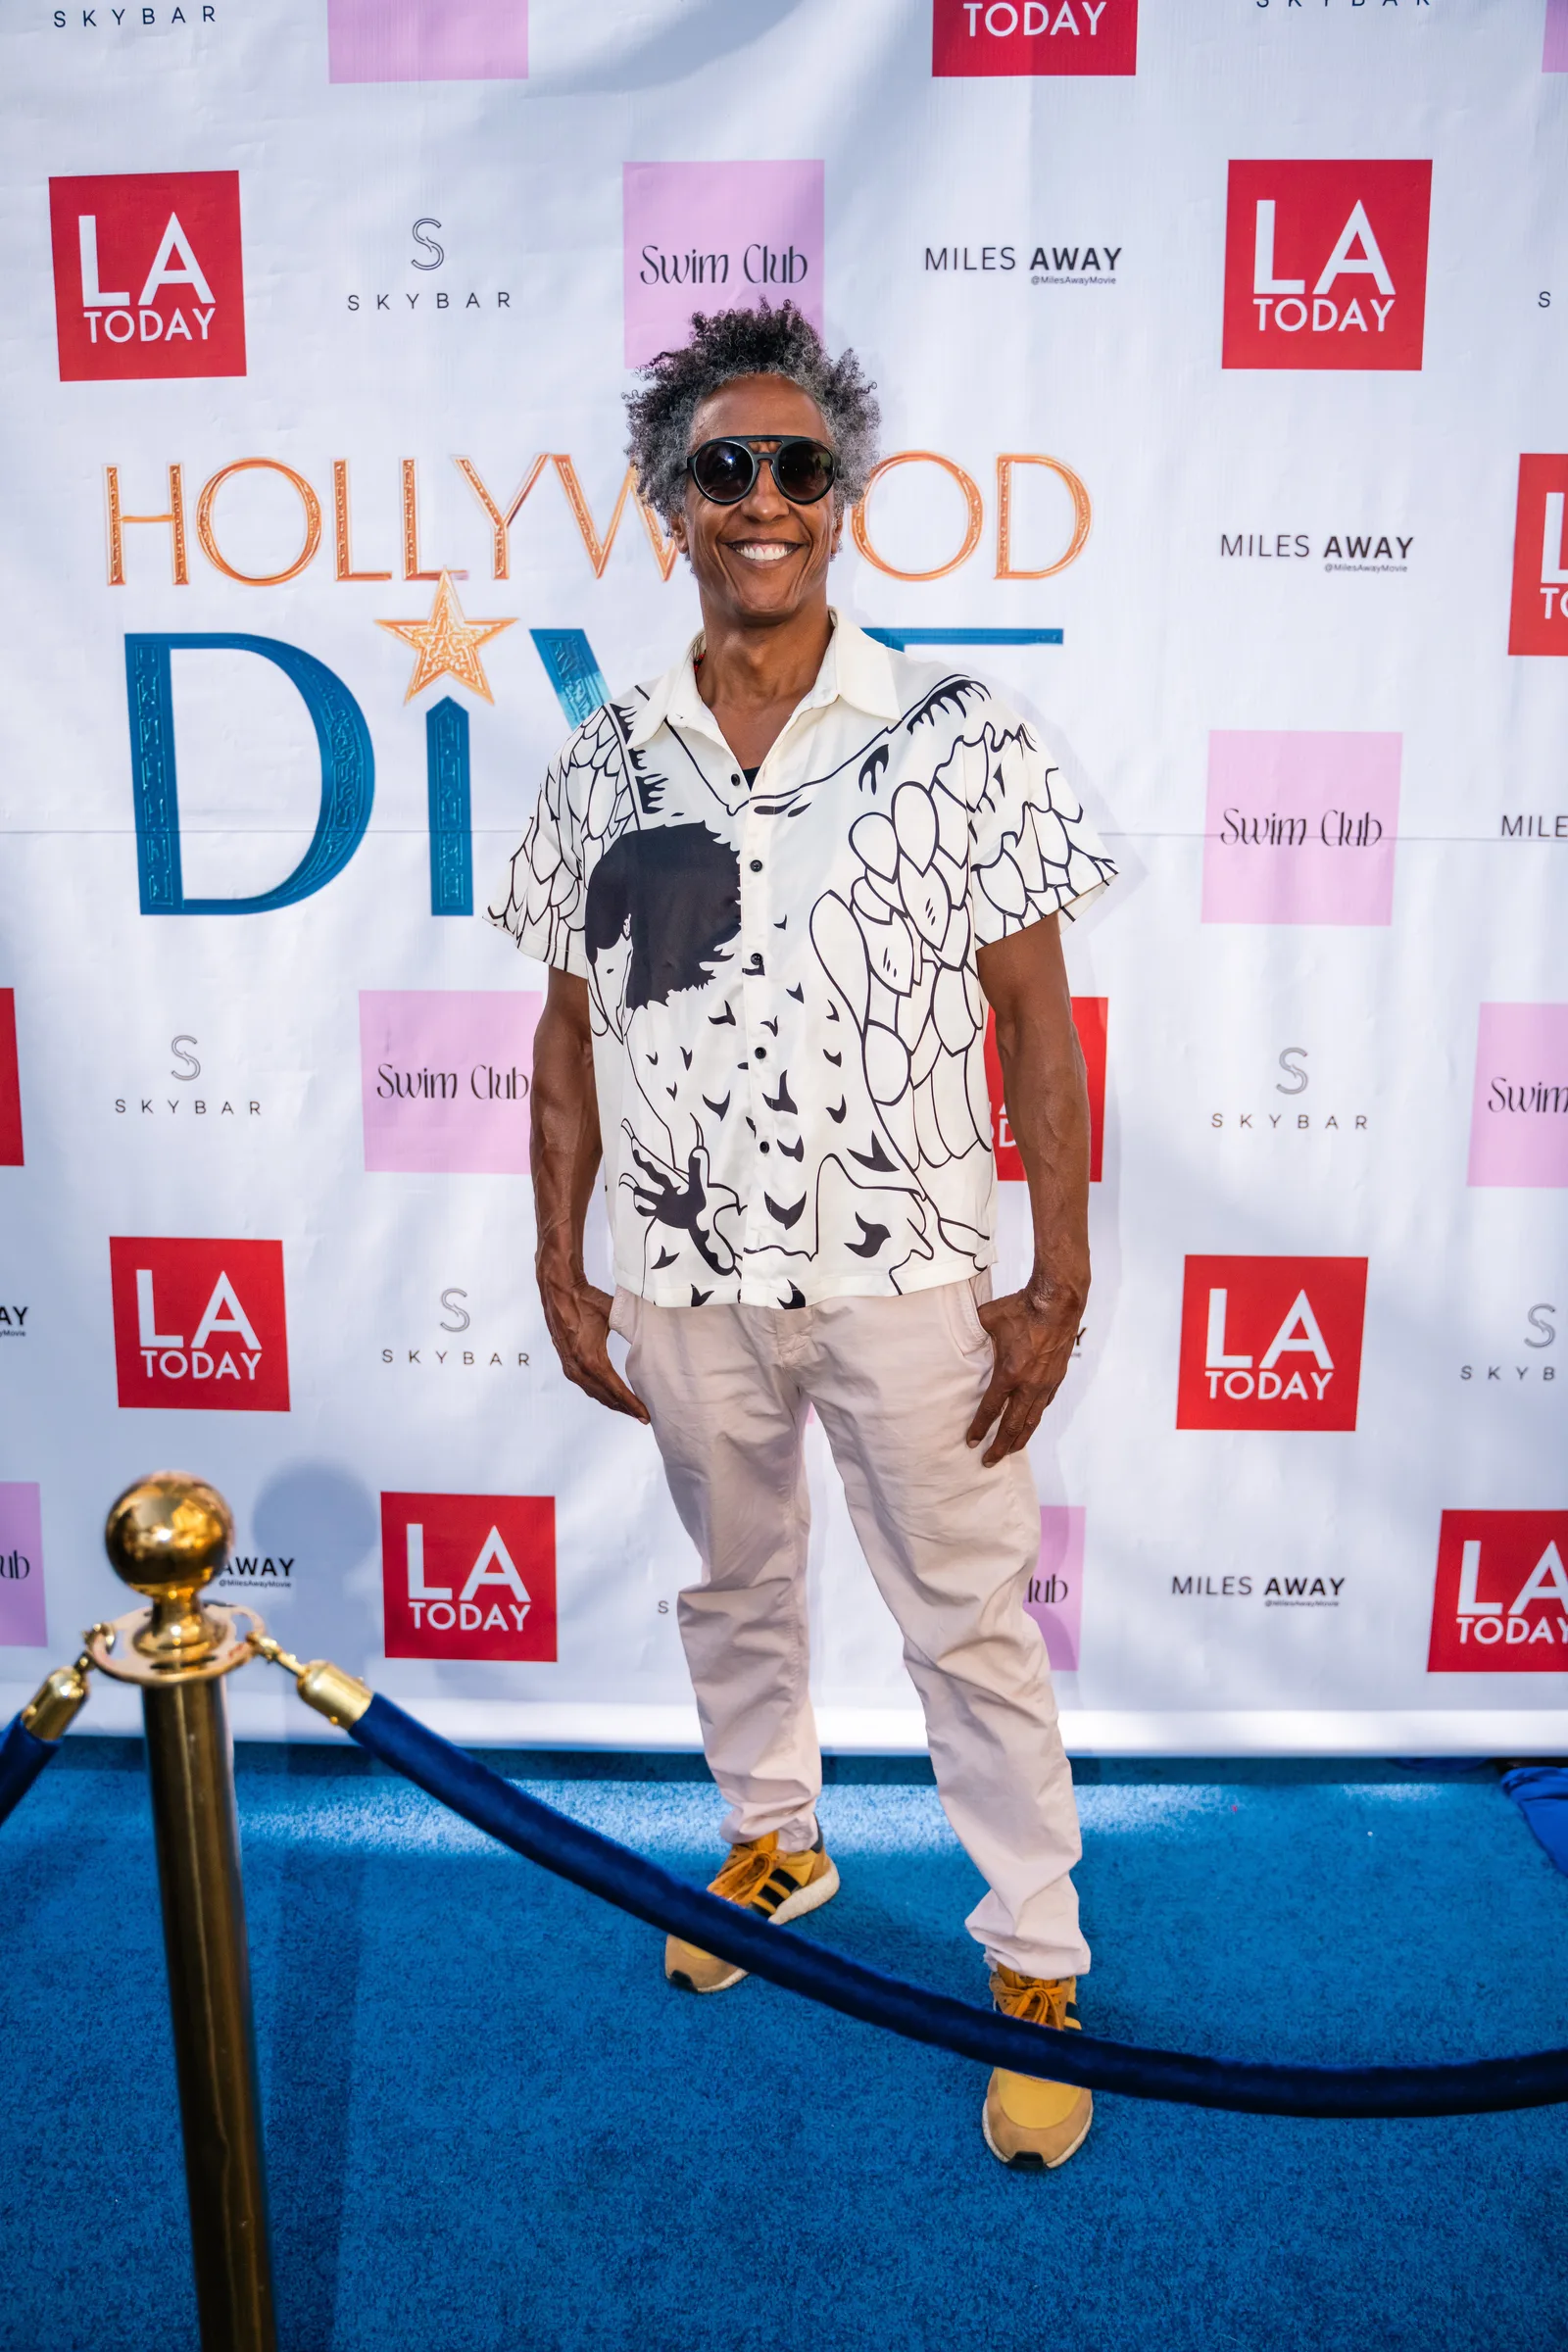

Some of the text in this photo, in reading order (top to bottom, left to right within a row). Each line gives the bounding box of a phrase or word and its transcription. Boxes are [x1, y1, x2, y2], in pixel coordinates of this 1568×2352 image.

[54, 5, 215, 27] SKYBAR
[963, 1, 1106, 37] TODAY
[78, 212, 216, 308] LA
[925, 247, 1122, 270] MILES AWAY
[1253, 199, 1396, 296] LA
[640, 244, 808, 285] Swim Club
[1030, 275, 1117, 286] @MilesAwayMovie
[347, 292, 511, 312] SKYBAR
[1253, 299, 1396, 332] TODAY
[83, 308, 216, 344] TODAY
[105, 450, 1093, 587] HOLLYWOD
[1221, 534, 1414, 559] MILES AWAY
[1541, 492, 1568, 584] L
[1324, 563, 1408, 574] @MilesAwayMovie
[1221, 808, 1383, 847] Swim Club
[1501, 814, 1568, 838] MILE
[376, 1063, 529, 1100] Swim Club
[1488, 1076, 1568, 1113] Swim
[115, 1099, 261, 1115] SKYBAR
[1211, 1113, 1368, 1130] SKYBAR
[0, 1306, 28, 1325] AY
[136, 1269, 263, 1350] LA
[1205, 1289, 1335, 1370] LA
[140, 1350, 263, 1381] TODAY
[381, 1348, 530, 1367] SKYBAR
[1460, 1365, 1555, 1381] SKYB
[1205, 1371, 1334, 1400] TODAY
[0, 1549, 30, 1580] ub
[407, 1523, 531, 1602] LA
[1456, 1540, 1568, 1615] LA
[1027, 1574, 1068, 1603] lub
[1172, 1575, 1346, 1595] MILES AWAY
[408, 1601, 532, 1632] TODAY
